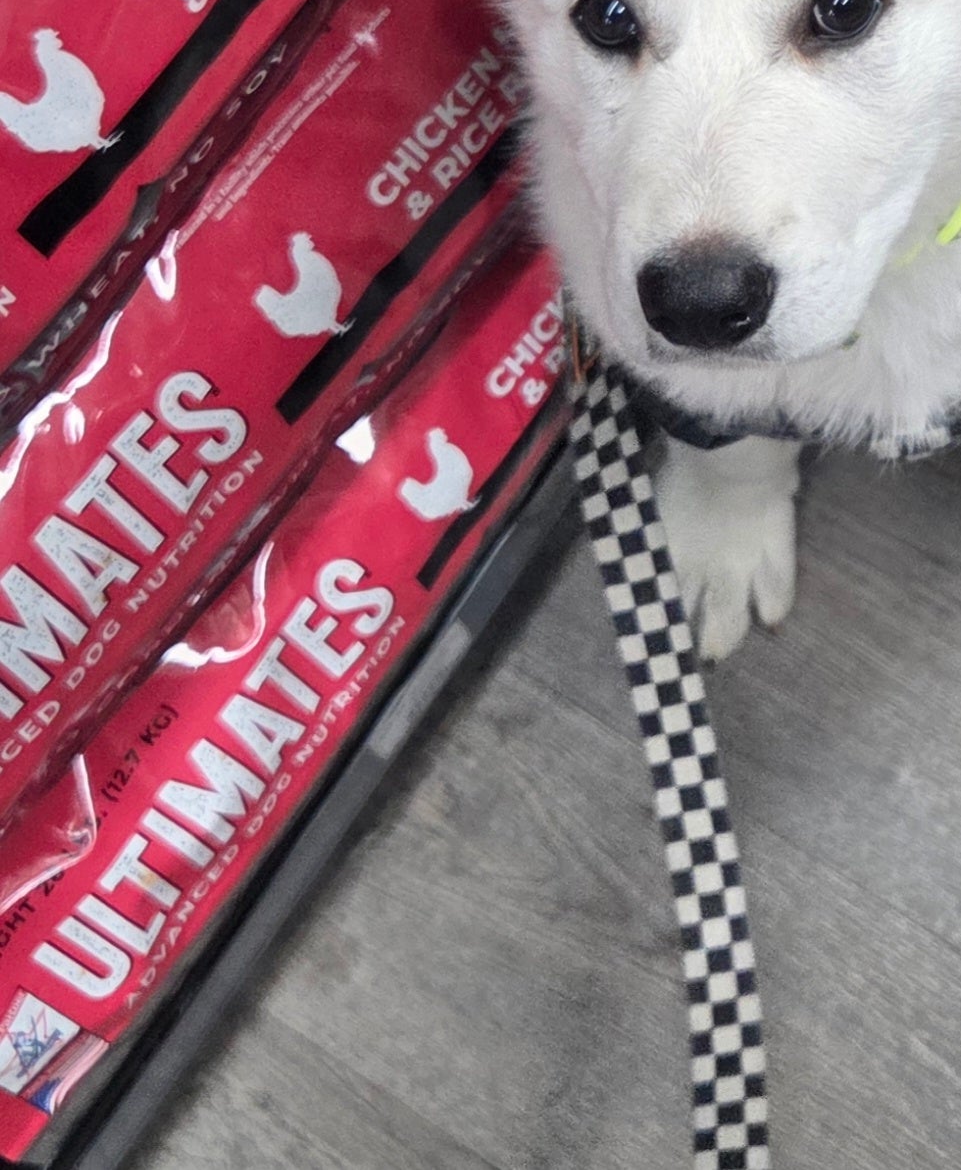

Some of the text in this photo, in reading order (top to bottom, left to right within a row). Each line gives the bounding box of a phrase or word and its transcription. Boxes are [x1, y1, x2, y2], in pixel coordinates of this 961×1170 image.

[166, 133, 217, 194] NO
[225, 39, 289, 123] SOY
[366, 44, 503, 209] CHICKEN
[404, 106, 507, 221] & RICE
[65, 618, 122, 691] DOG
[126, 449, 265, 610] NUTRITION
[31, 558, 396, 1000] ULTIMATES
[101, 752, 146, 805] (12.7
[140, 703, 180, 747] KG)
[123, 614, 407, 1011] ADVANCED DOG NUTRITION
